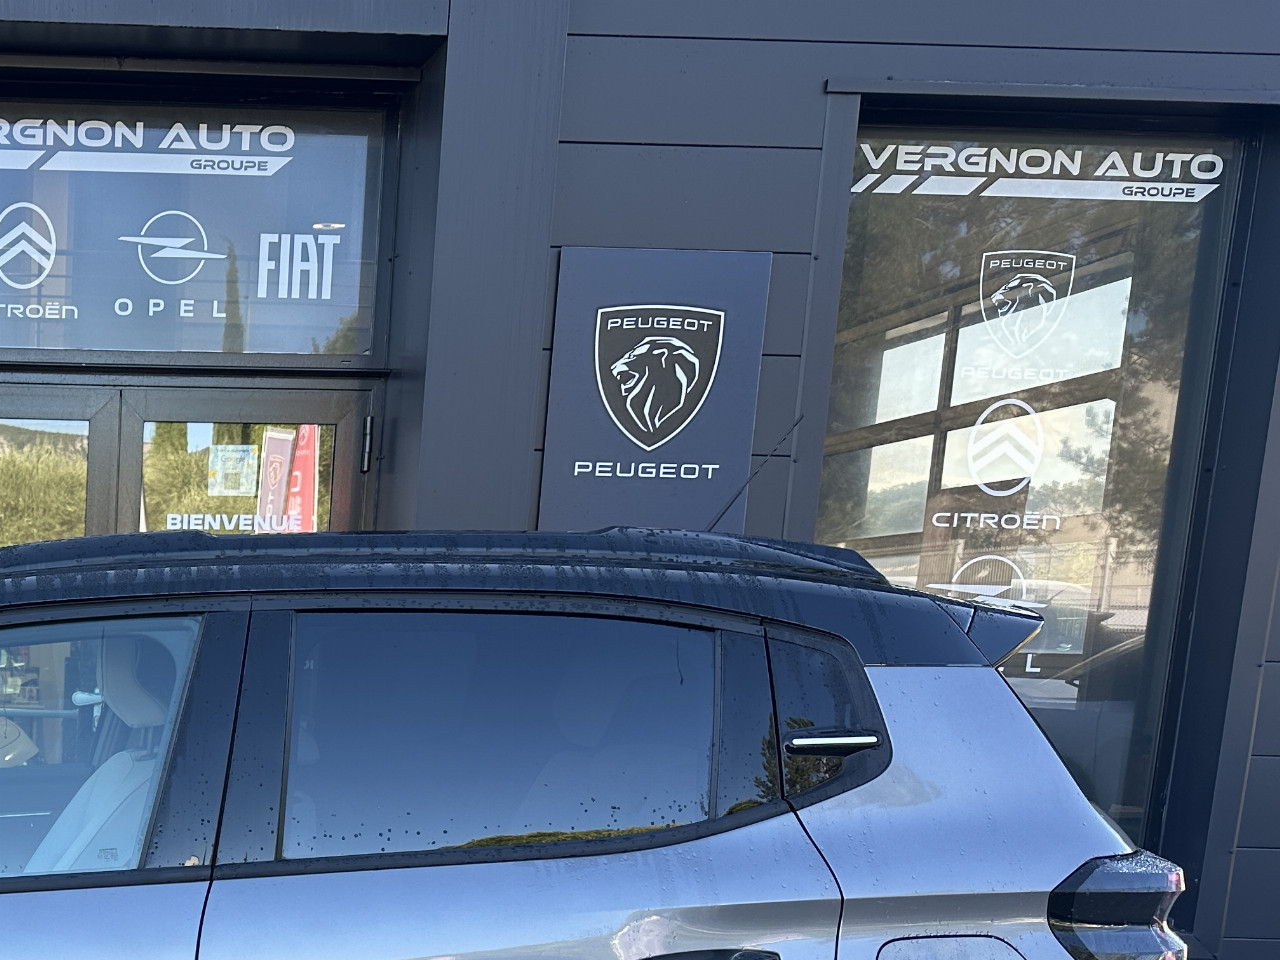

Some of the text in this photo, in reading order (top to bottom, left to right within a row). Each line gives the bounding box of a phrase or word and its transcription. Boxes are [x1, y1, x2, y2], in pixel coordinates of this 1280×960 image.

[158, 122, 296, 151] AUTO
[190, 159, 269, 171] GROUPE
[860, 143, 1225, 179] VERGNON AUTO
[1122, 186, 1196, 198] GROUPE
[257, 233, 341, 299] FIAT
[989, 258, 1068, 271] PEUGEOT
[114, 298, 227, 317] OPEL
[607, 317, 713, 331] PEUGEOT
[961, 366, 1070, 381] PEUGEOT
[574, 462, 720, 479] PEUGEOT
[167, 514, 302, 531] BIENVENUE
